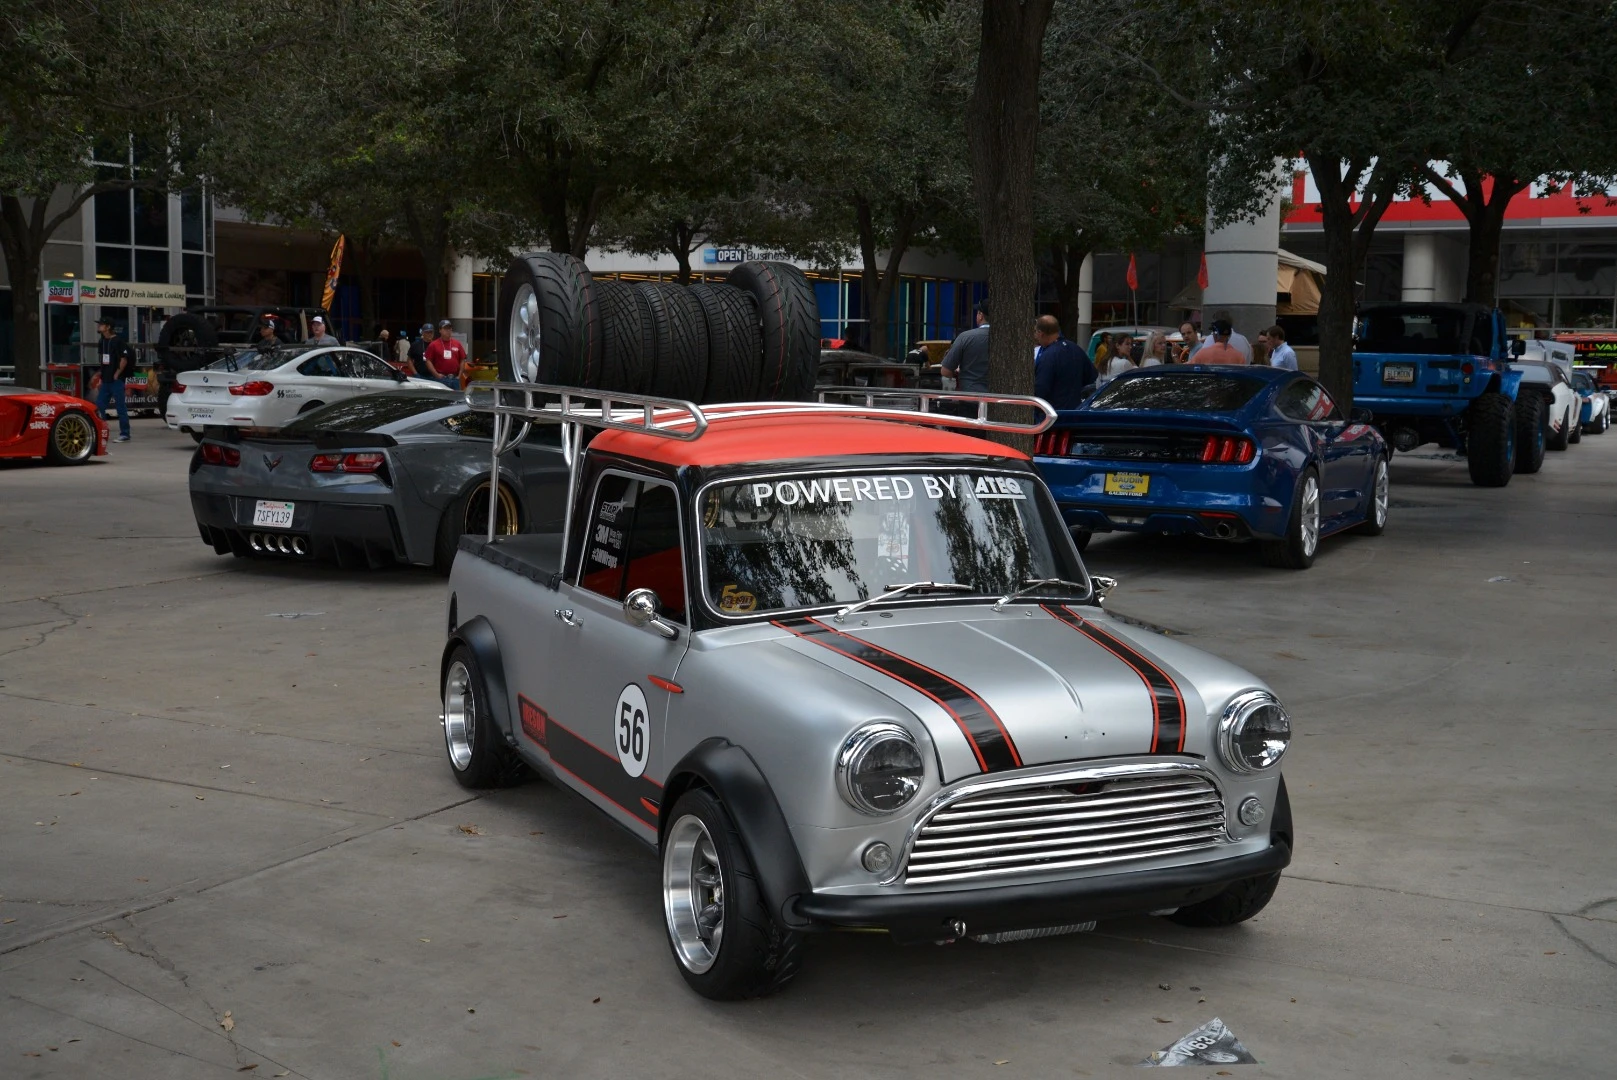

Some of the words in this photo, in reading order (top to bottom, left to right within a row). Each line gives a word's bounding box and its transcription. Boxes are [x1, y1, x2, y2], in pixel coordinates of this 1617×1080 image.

[718, 250, 742, 261] OPEN
[49, 285, 73, 296] sbarro
[98, 285, 130, 298] sbarro
[131, 290, 146, 298] Fresh
[164, 291, 185, 300] Cooking
[752, 476, 914, 508] POWERED
[975, 477, 1022, 496] ATEQ
[256, 509, 291, 524] 7SFY139
[595, 524, 610, 544] 3M
[619, 701, 645, 762] 56
